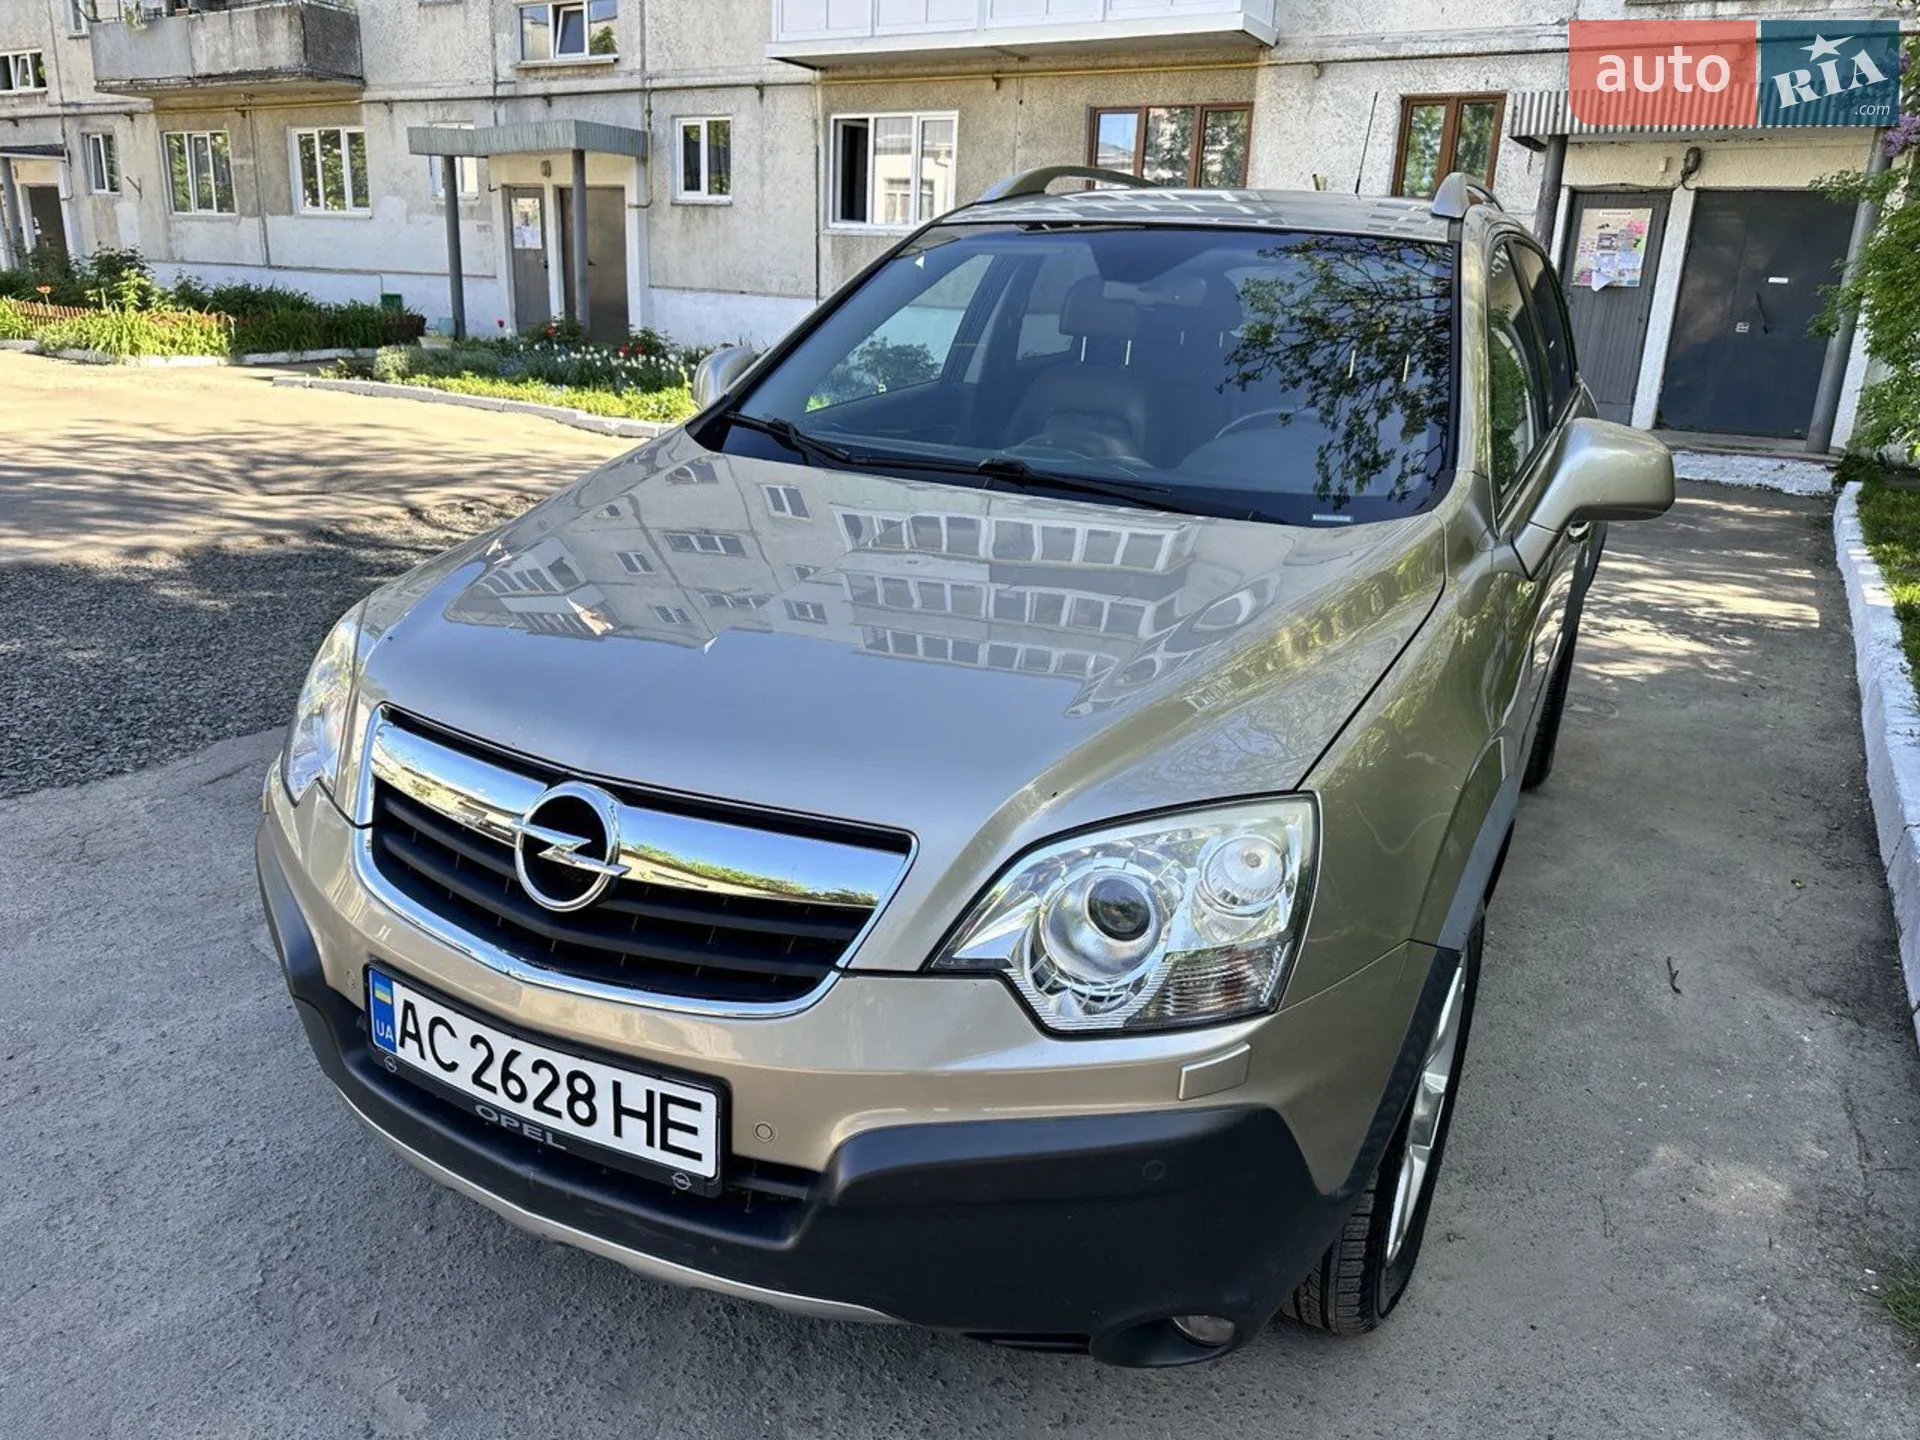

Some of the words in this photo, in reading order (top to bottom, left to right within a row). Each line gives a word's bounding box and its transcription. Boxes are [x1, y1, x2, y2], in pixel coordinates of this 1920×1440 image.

[376, 1020, 393, 1042] UA
[399, 999, 459, 1072] AC
[470, 1034, 597, 1127] 2628
[613, 1080, 702, 1162] HE
[475, 1104, 567, 1150] OPEL
